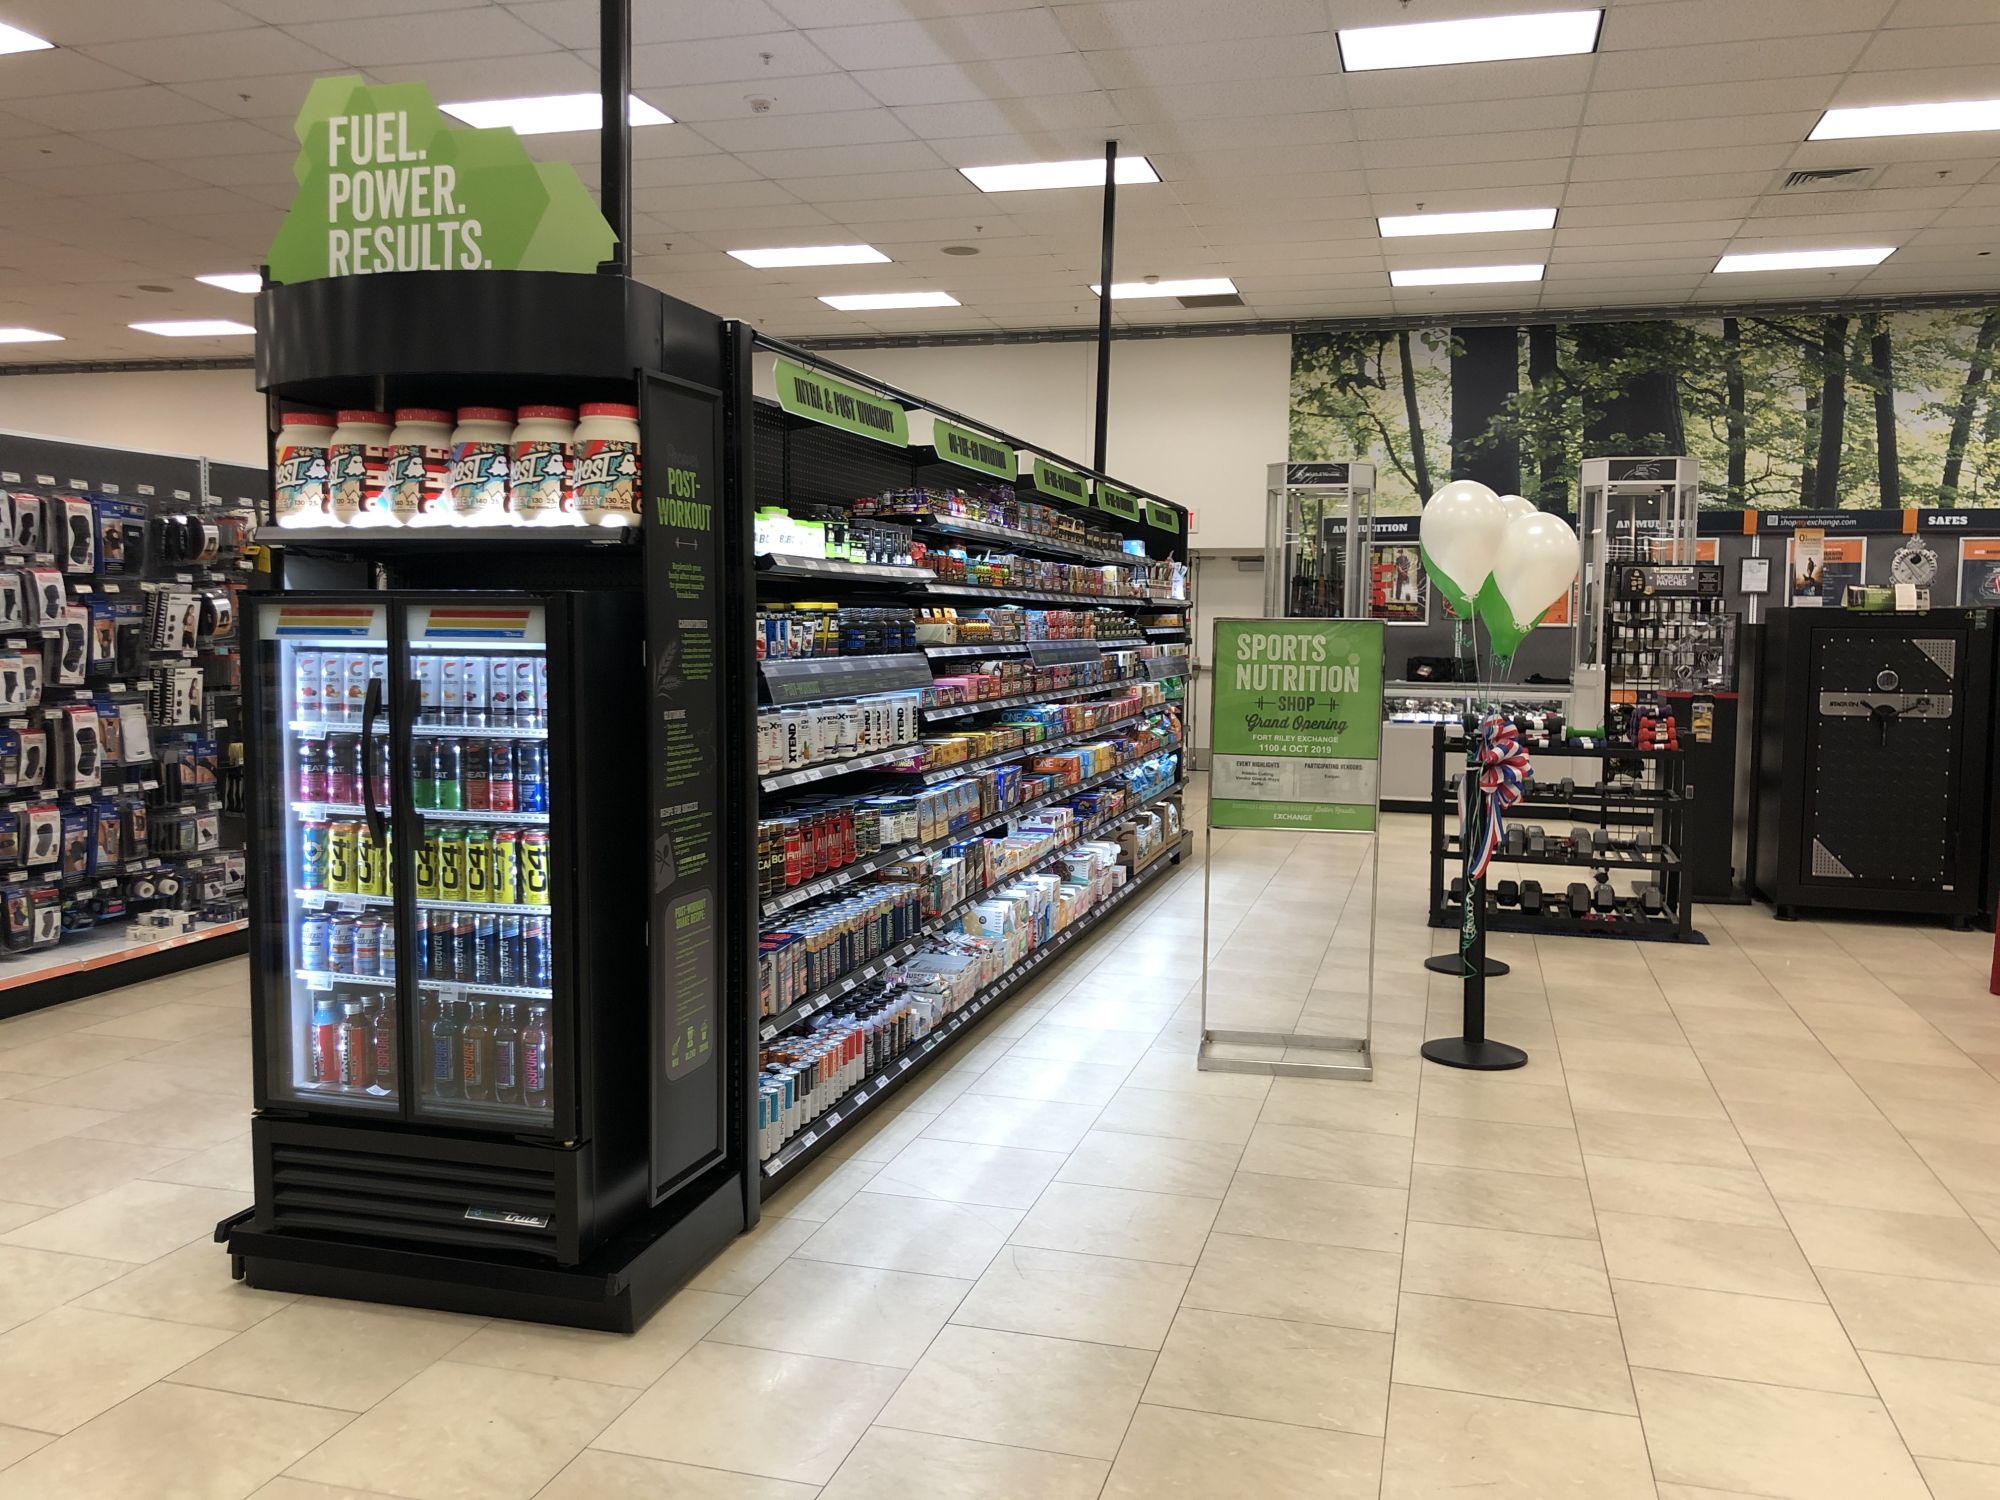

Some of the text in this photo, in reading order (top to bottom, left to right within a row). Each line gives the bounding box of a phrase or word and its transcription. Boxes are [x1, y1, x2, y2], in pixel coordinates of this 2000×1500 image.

[329, 111, 427, 166] FUEL.
[329, 164, 466, 223] POWER.
[329, 219, 492, 277] RESULTS.
[794, 377, 894, 433] INTRA & POST WORKOUT
[667, 466, 701, 498] POST-
[656, 496, 712, 531] WORKOUT
[1928, 516, 1968, 525] SAFES
[1236, 633, 1327, 662] SPORTS
[1236, 664, 1360, 693] NUTRITION
[1001, 712, 1022, 723] ONE
[1278, 696, 1315, 712] SHOP
[788, 723, 797, 763] XTEND
[1245, 713, 1348, 735] Grand Opening
[1033, 759, 1054, 768] ONE
[1259, 744, 1279, 752] 1100
[1289, 745, 1308, 753] OCT
[1311, 745, 1331, 754] 2019
[1273, 813, 1312, 821] EXCHANGE
[332, 839, 347, 882] C4
[359, 839, 373, 883] C4
[417, 843, 435, 887] C4
[442, 845, 462, 889] C4
[468, 846, 488, 890] C4
[528, 848, 547, 892] C4
[434, 935, 443, 971] RECOVER
[464, 1043, 474, 1081] ISOPURE
[526, 1048, 538, 1088] ISOPURE
